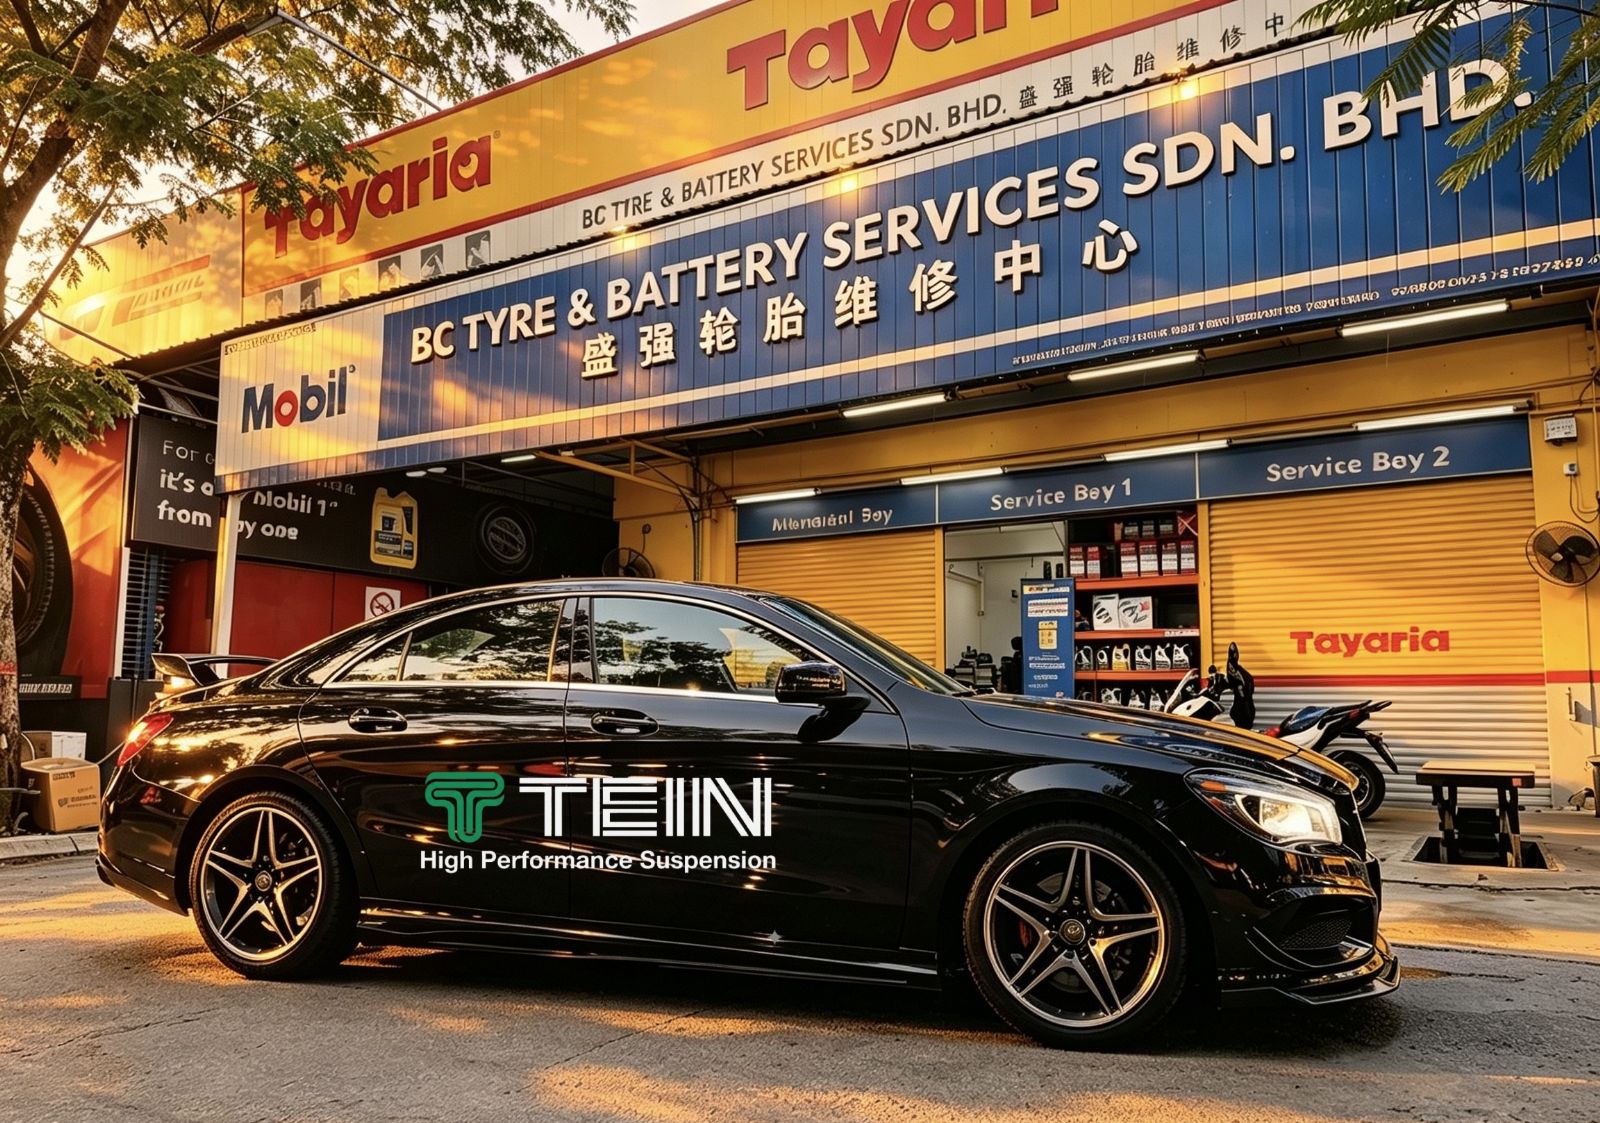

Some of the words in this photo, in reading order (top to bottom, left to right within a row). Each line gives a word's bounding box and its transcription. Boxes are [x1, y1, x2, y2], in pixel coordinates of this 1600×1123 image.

[582, 205, 607, 230] BC
[660, 186, 675, 208] &
[681, 160, 765, 203] BATTERY
[770, 128, 875, 177] SERVICES
[880, 112, 940, 146] SDN.
[947, 93, 1007, 128] BHD.
[264, 134, 492, 259] Tayaria
[411, 320, 455, 365] BC
[462, 296, 557, 350] TYRE
[568, 288, 596, 328] &
[607, 233, 809, 320] BATTERY
[823, 157, 1101, 268] SERVICES
[1122, 112, 1296, 196] SDN.
[1324, 58, 1533, 152] BHD.
[581, 219, 1139, 379] 盛强轮胎维修中心
[241, 365, 348, 434] Mobil
[1267, 456, 1362, 482] Service
[1433, 446, 1450, 467] 2
[157, 499, 212, 528] from
[260, 523, 299, 540] one
[991, 488, 1066, 511] Service
[1122, 478, 1132, 496] 1
[1289, 626, 1450, 658] Tayaria
[519, 777, 772, 837] TEIN
[420, 850, 474, 874] High
[481, 850, 633, 870] Performance
[640, 850, 777, 874] Suspension
